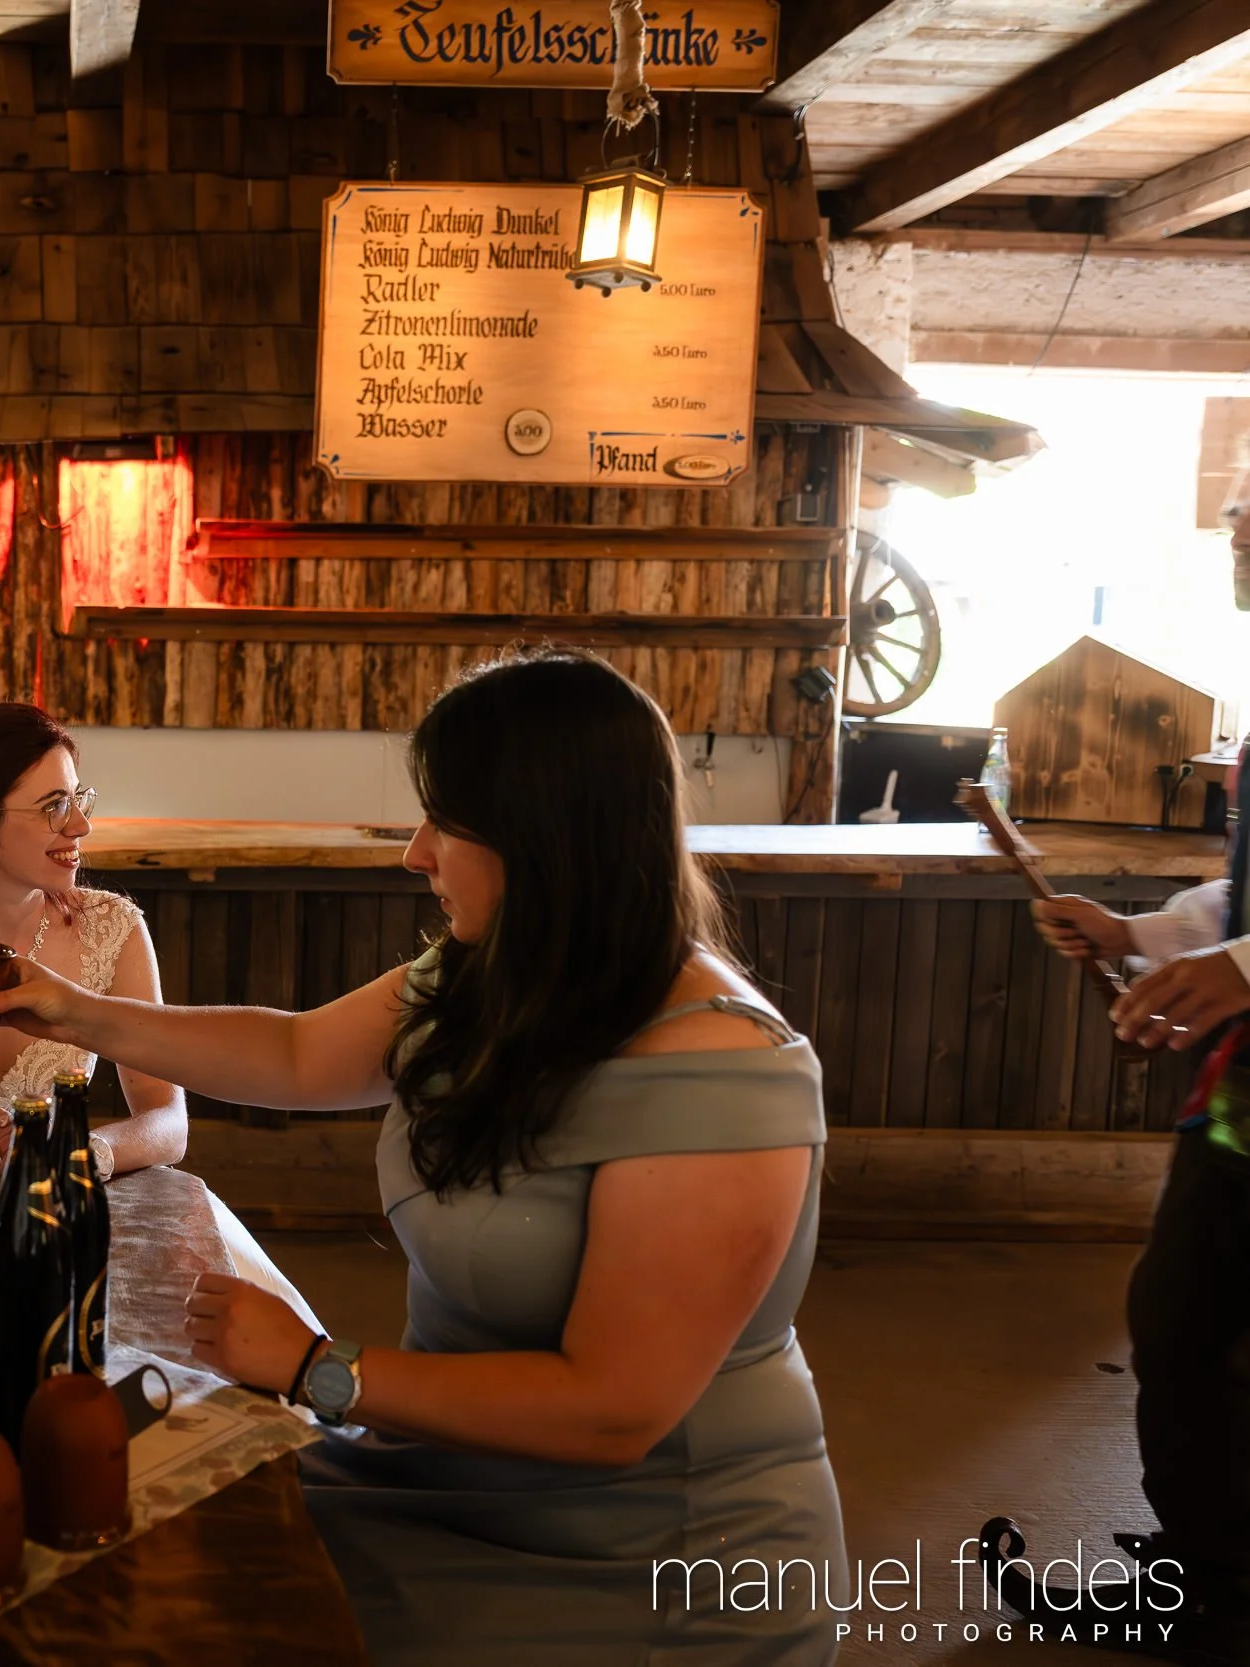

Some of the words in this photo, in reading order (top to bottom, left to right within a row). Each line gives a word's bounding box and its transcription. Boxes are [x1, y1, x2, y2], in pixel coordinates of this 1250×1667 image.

[393, 0, 720, 77] Teufelsscänke
[360, 205, 410, 238] König
[418, 204, 484, 238] Ludwig
[491, 205, 561, 236] Dunkel
[358, 240, 410, 273] König
[417, 238, 480, 273] Ludwig
[360, 273, 440, 304] Radler
[359, 308, 538, 338] Zitronenlimonade
[359, 343, 406, 371] Cola
[417, 343, 468, 371] Mix
[355, 376, 483, 412] Apfelschorle
[355, 412, 448, 438] Wasser
[596, 445, 658, 477] Pfand
